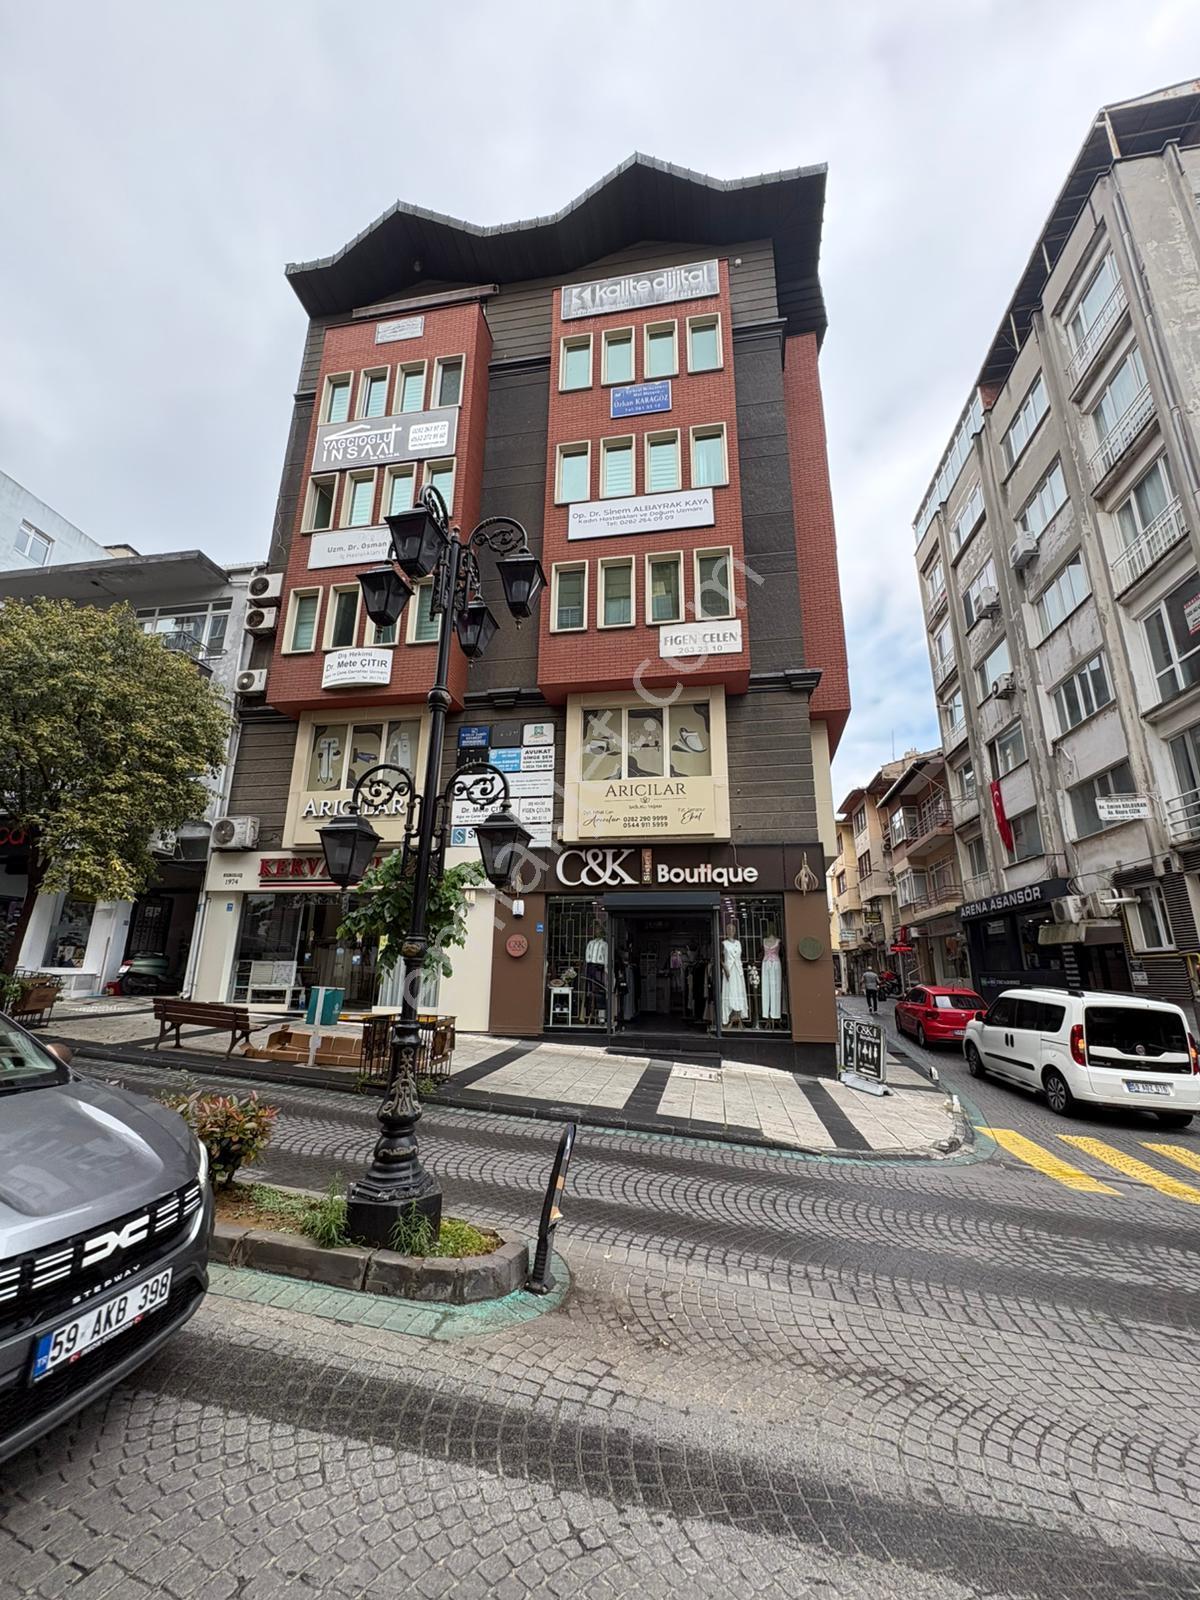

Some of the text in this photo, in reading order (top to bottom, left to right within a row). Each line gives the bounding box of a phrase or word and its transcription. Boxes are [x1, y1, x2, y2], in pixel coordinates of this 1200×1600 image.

[653, 264, 707, 292] dijital
[633, 501, 682, 512] ALBAYRAK
[685, 498, 709, 507] KAYA
[361, 541, 387, 549] Osman
[337, 661, 358, 669] Mete
[360, 658, 388, 668] ÇITIR
[605, 783, 687, 798] ARICILAR
[556, 849, 639, 886] C&K
[657, 863, 759, 887] Boutique
[960, 886, 1042, 918] ARENA ASANSÖR
[72, 1264, 141, 1304] STEPWAY
[50, 1323, 79, 1362] 59
[90, 1295, 128, 1341] AKB
[138, 1272, 169, 1310] 398
